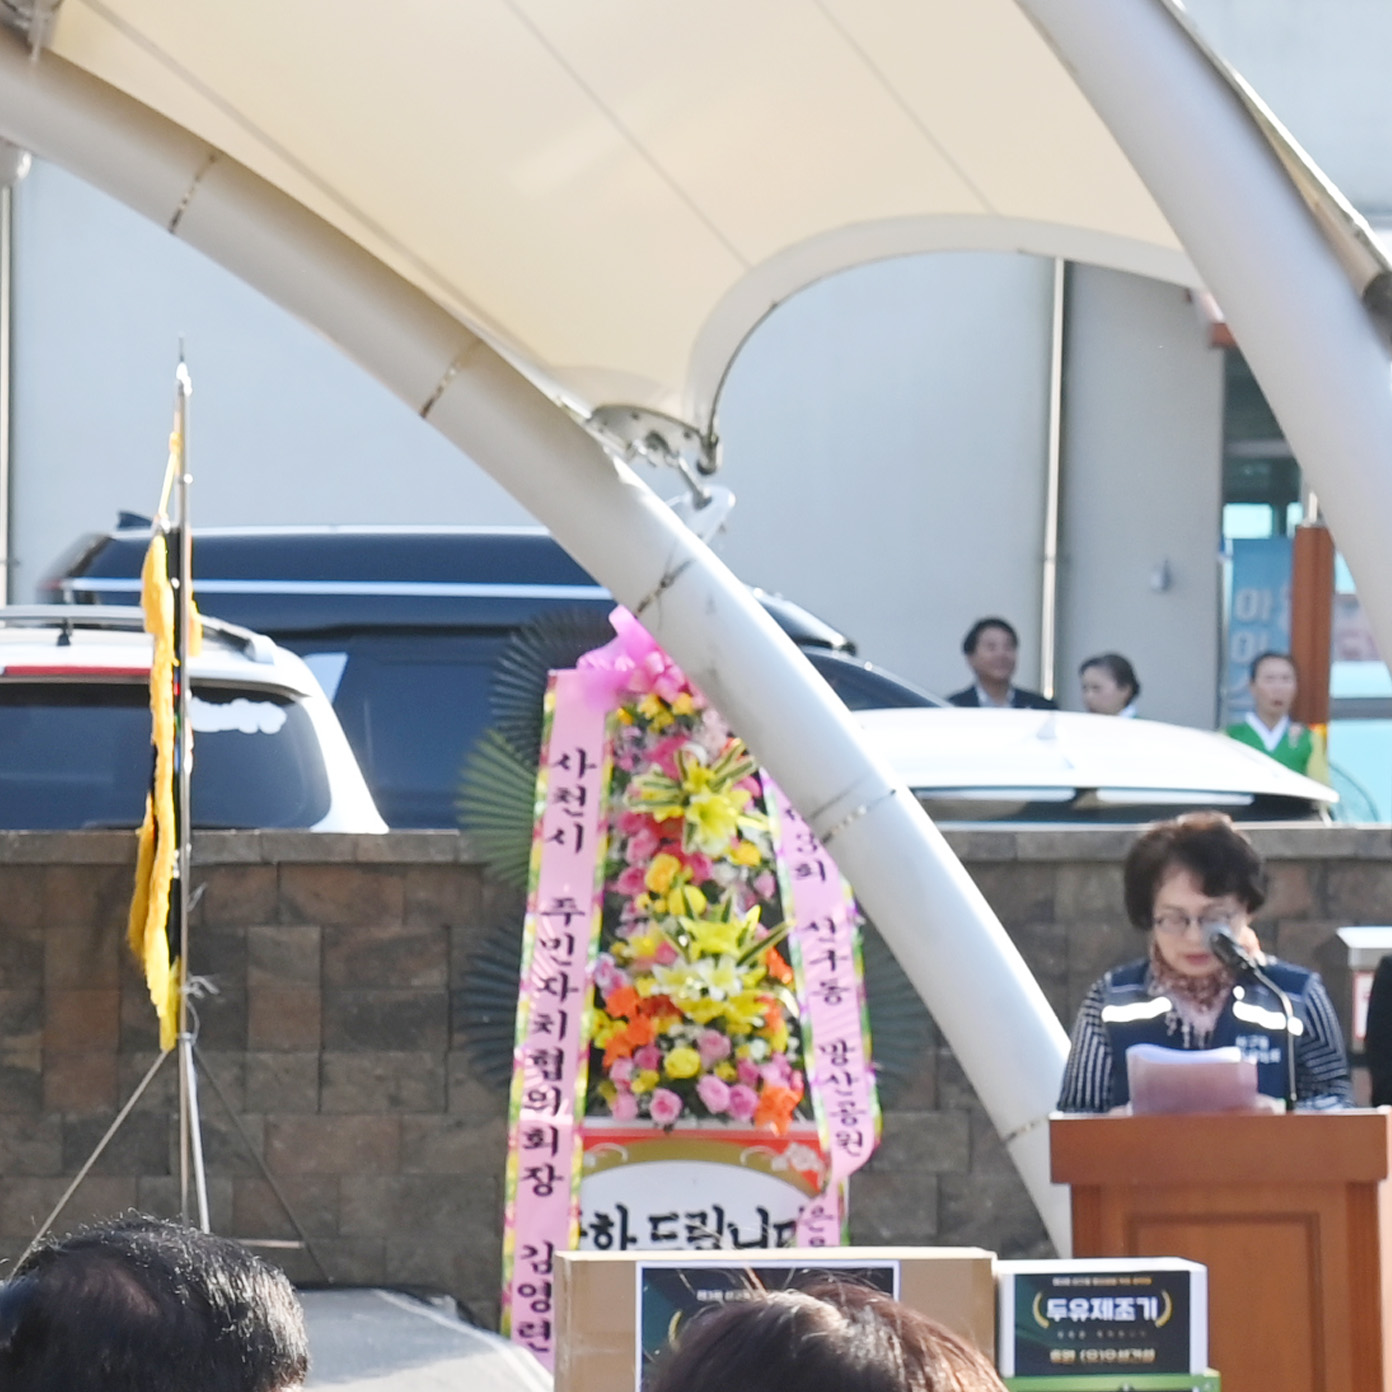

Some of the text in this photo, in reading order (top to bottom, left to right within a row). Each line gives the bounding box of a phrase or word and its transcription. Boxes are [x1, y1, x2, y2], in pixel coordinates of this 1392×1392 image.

[548, 746, 597, 855] 사천시
[785, 808, 826, 883] 3회
[819, 1038, 866, 1157] 망산공원
[1046, 1296, 1158, 1322] 두유제조기
